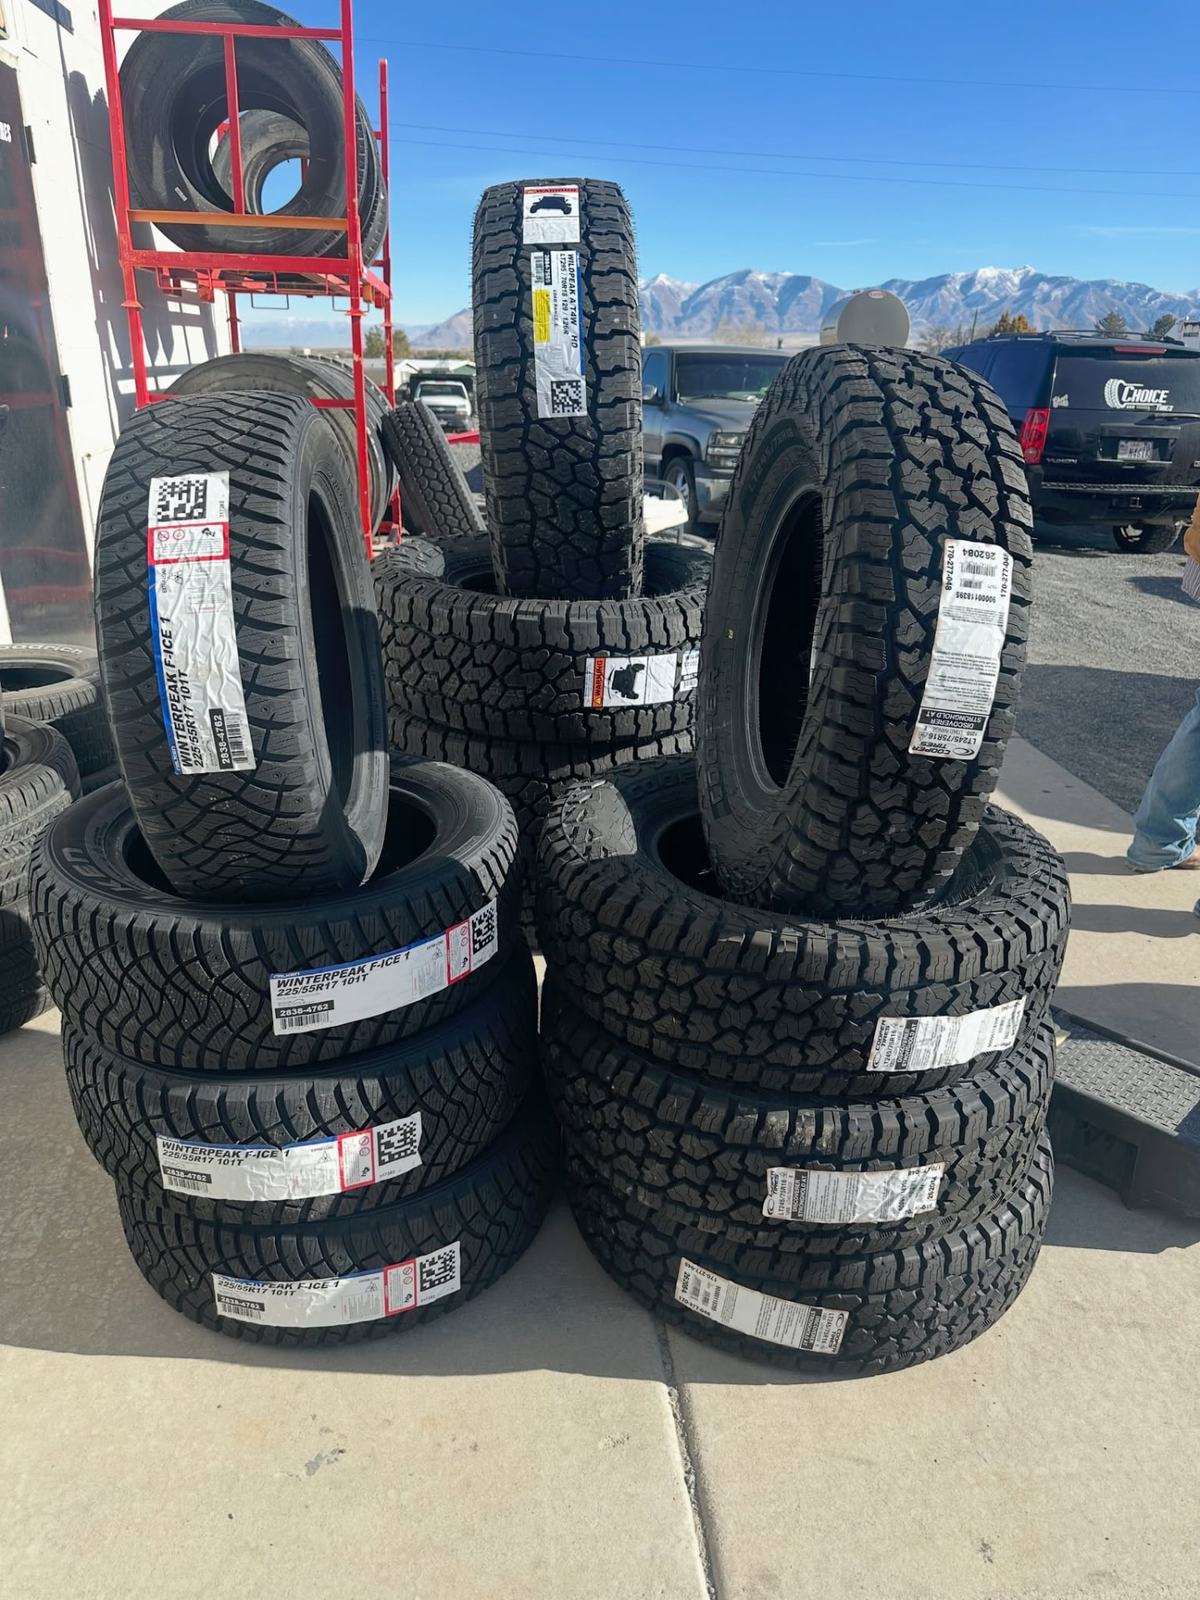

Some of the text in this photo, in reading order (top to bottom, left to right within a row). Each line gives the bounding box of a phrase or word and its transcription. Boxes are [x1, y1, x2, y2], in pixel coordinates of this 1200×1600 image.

[567, 253, 576, 295] WILDPEAK
[571, 334, 578, 349] HD
[1121, 385, 1169, 404] CHOICE
[962, 548, 996, 560] 262084
[945, 545, 954, 591] 170-277-048
[161, 628, 176, 668] F-ICE
[178, 669, 192, 700] 101T
[595, 660, 604, 698] WARNING
[166, 672, 193, 767] WINTERPEAK
[930, 718, 974, 729] DISCOVERER
[936, 712, 982, 723] STRONGHOLD
[214, 714, 230, 765] 2838-4762
[920, 741, 947, 749] TIRES
[928, 733, 976, 745] LT245/75R16
[912, 746, 952, 754] COOPER
[276, 952, 410, 988] WINTERPEAK F-ICE 1
[276, 973, 369, 997] 225/55R17 101T
[280, 1004, 329, 1017] 2838-4762
[162, 1141, 241, 1158] WINTERPEAK
[244, 1150, 278, 1159] F-ICE
[162, 1149, 244, 1166] 225/55R17 101T
[166, 1168, 208, 1182] 2838-4762
[218, 1280, 268, 1294] 225/55R17
[297, 1282, 329, 1290] F-ICE
